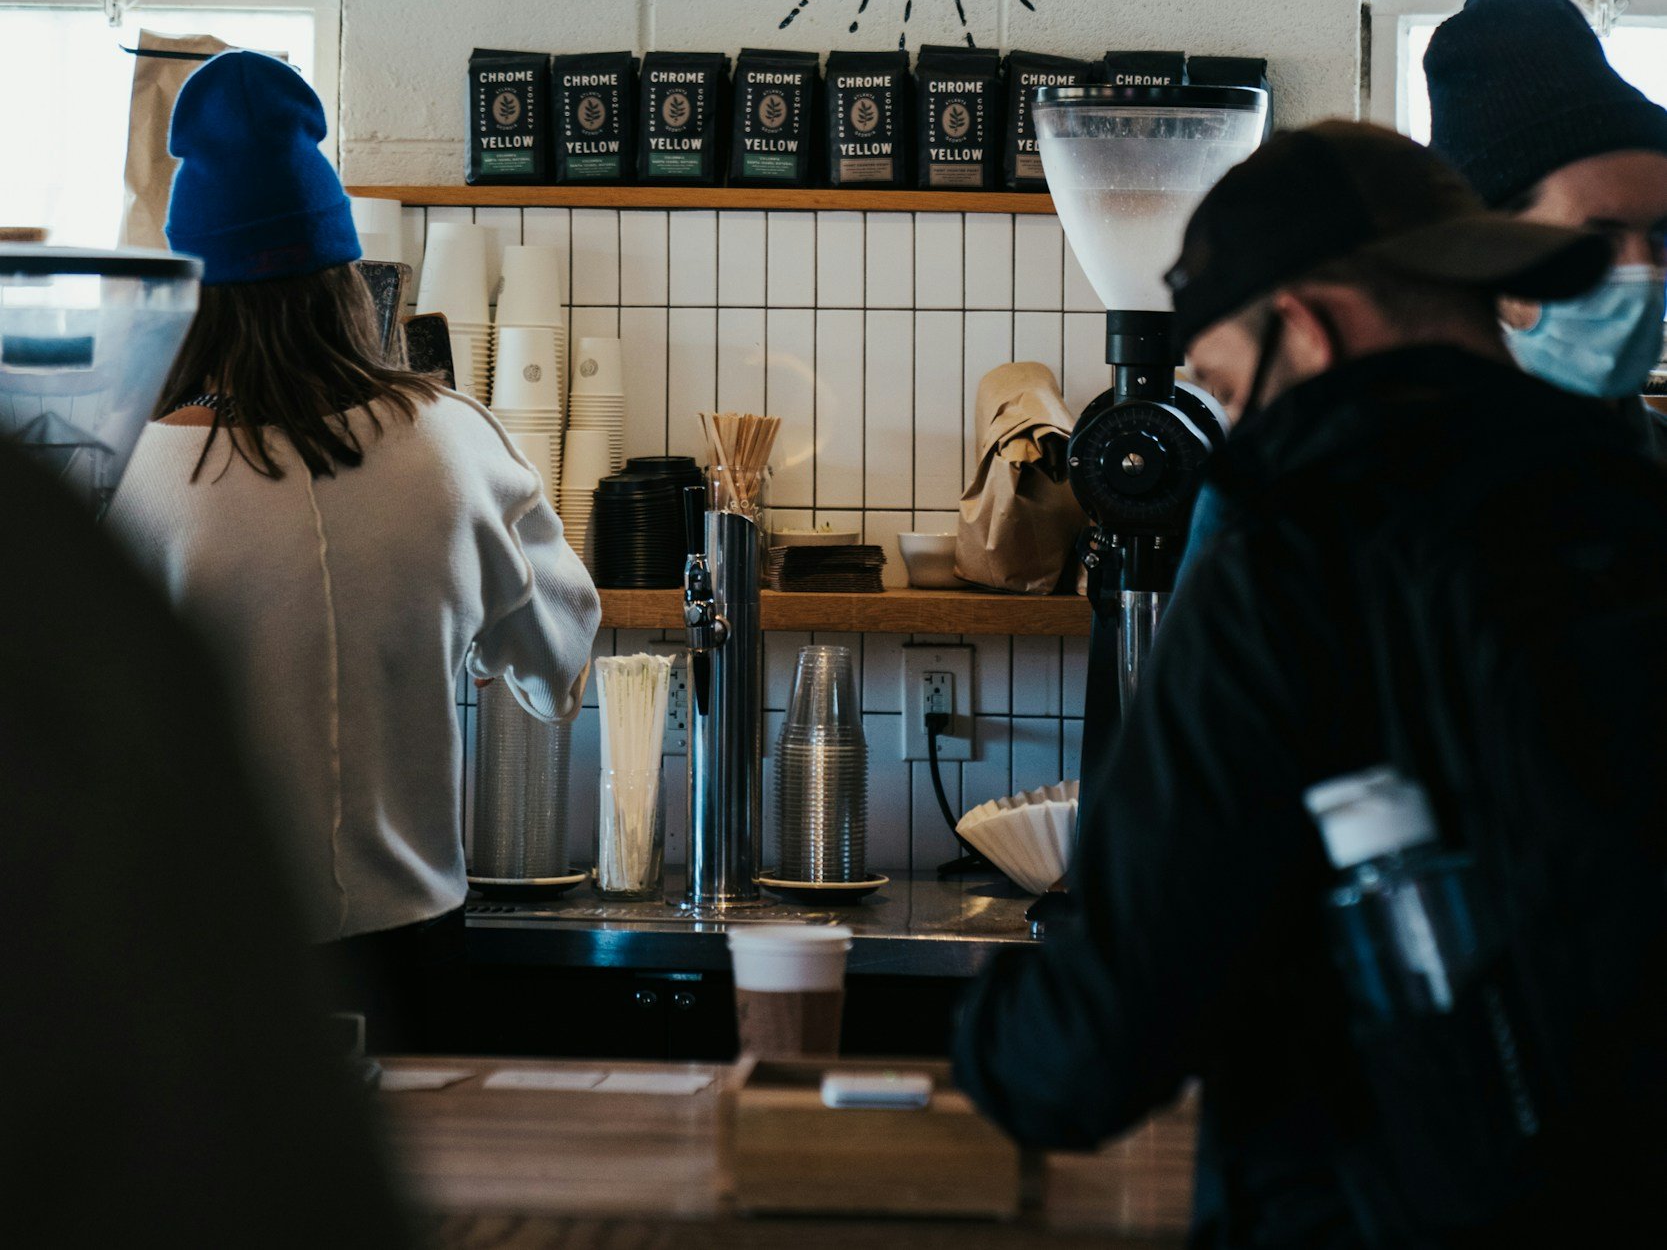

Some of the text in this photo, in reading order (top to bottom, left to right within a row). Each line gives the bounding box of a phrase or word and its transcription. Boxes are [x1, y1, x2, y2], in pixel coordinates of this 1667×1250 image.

[480, 71, 533, 83] CHROME
[563, 74, 618, 87] CHROME
[650, 71, 705, 83] CHROME
[747, 72, 802, 85] CHROME
[837, 76, 891, 88] CHROME
[1021, 74, 1076, 86] CHROME
[929, 81, 983, 93] CHROME
[564, 92, 572, 136] TRADING
[744, 88, 752, 133] TRADING
[837, 93, 845, 138] TRADING
[1017, 90, 1026, 134] TRADING
[976, 98, 984, 142] COMPANY
[481, 136, 533, 149] YELLOW
[566, 141, 620, 154] YELLOW
[649, 138, 702, 150] YELLOW
[744, 138, 798, 152] YELLOW
[1017, 140, 1040, 151] YEL
[840, 143, 892, 156] YELLOW
[929, 148, 983, 161] YELLOW
